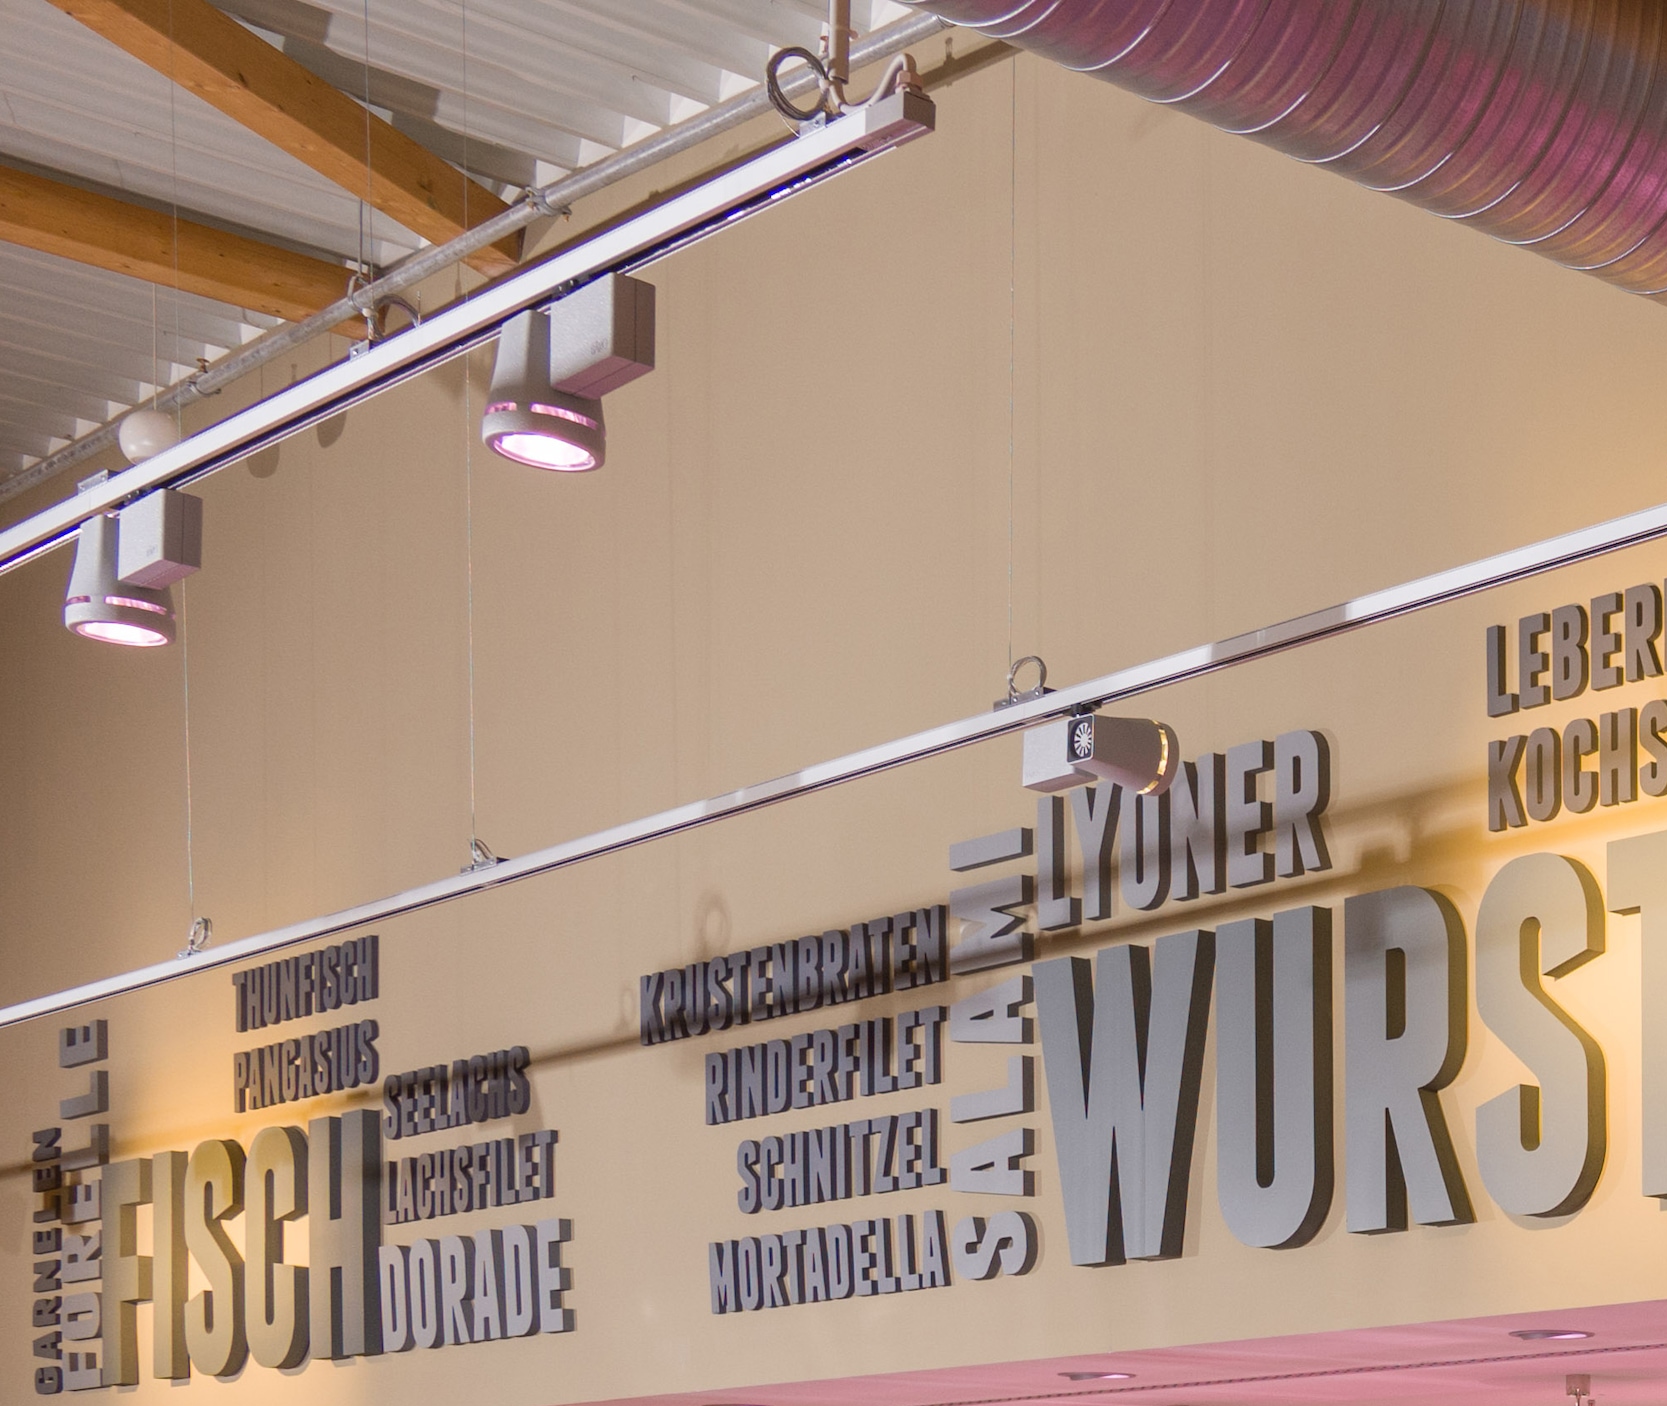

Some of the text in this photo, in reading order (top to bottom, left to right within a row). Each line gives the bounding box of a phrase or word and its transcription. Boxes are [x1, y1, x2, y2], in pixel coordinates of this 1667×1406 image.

[1037, 728, 1333, 930] LYONER
[232, 935, 379, 1032] THUNFISCH
[640, 904, 948, 1046] KRUSTENBRATEN
[233, 1020, 379, 1113] PANGASIUS
[383, 1046, 531, 1140] SEELACHS
[705, 1005, 947, 1125] RINDERFILET
[949, 827, 1040, 1280] SALAMI
[60, 1019, 108, 1391] FORELLE
[384, 1129, 559, 1225] LACHSFILET
[737, 1108, 947, 1214] SCHNITZEL
[33, 1127, 62, 1395] GARNELEN
[100, 1109, 384, 1386] FISCH
[379, 1218, 575, 1352] DORADE
[709, 1209, 952, 1315] MORTADELLA
